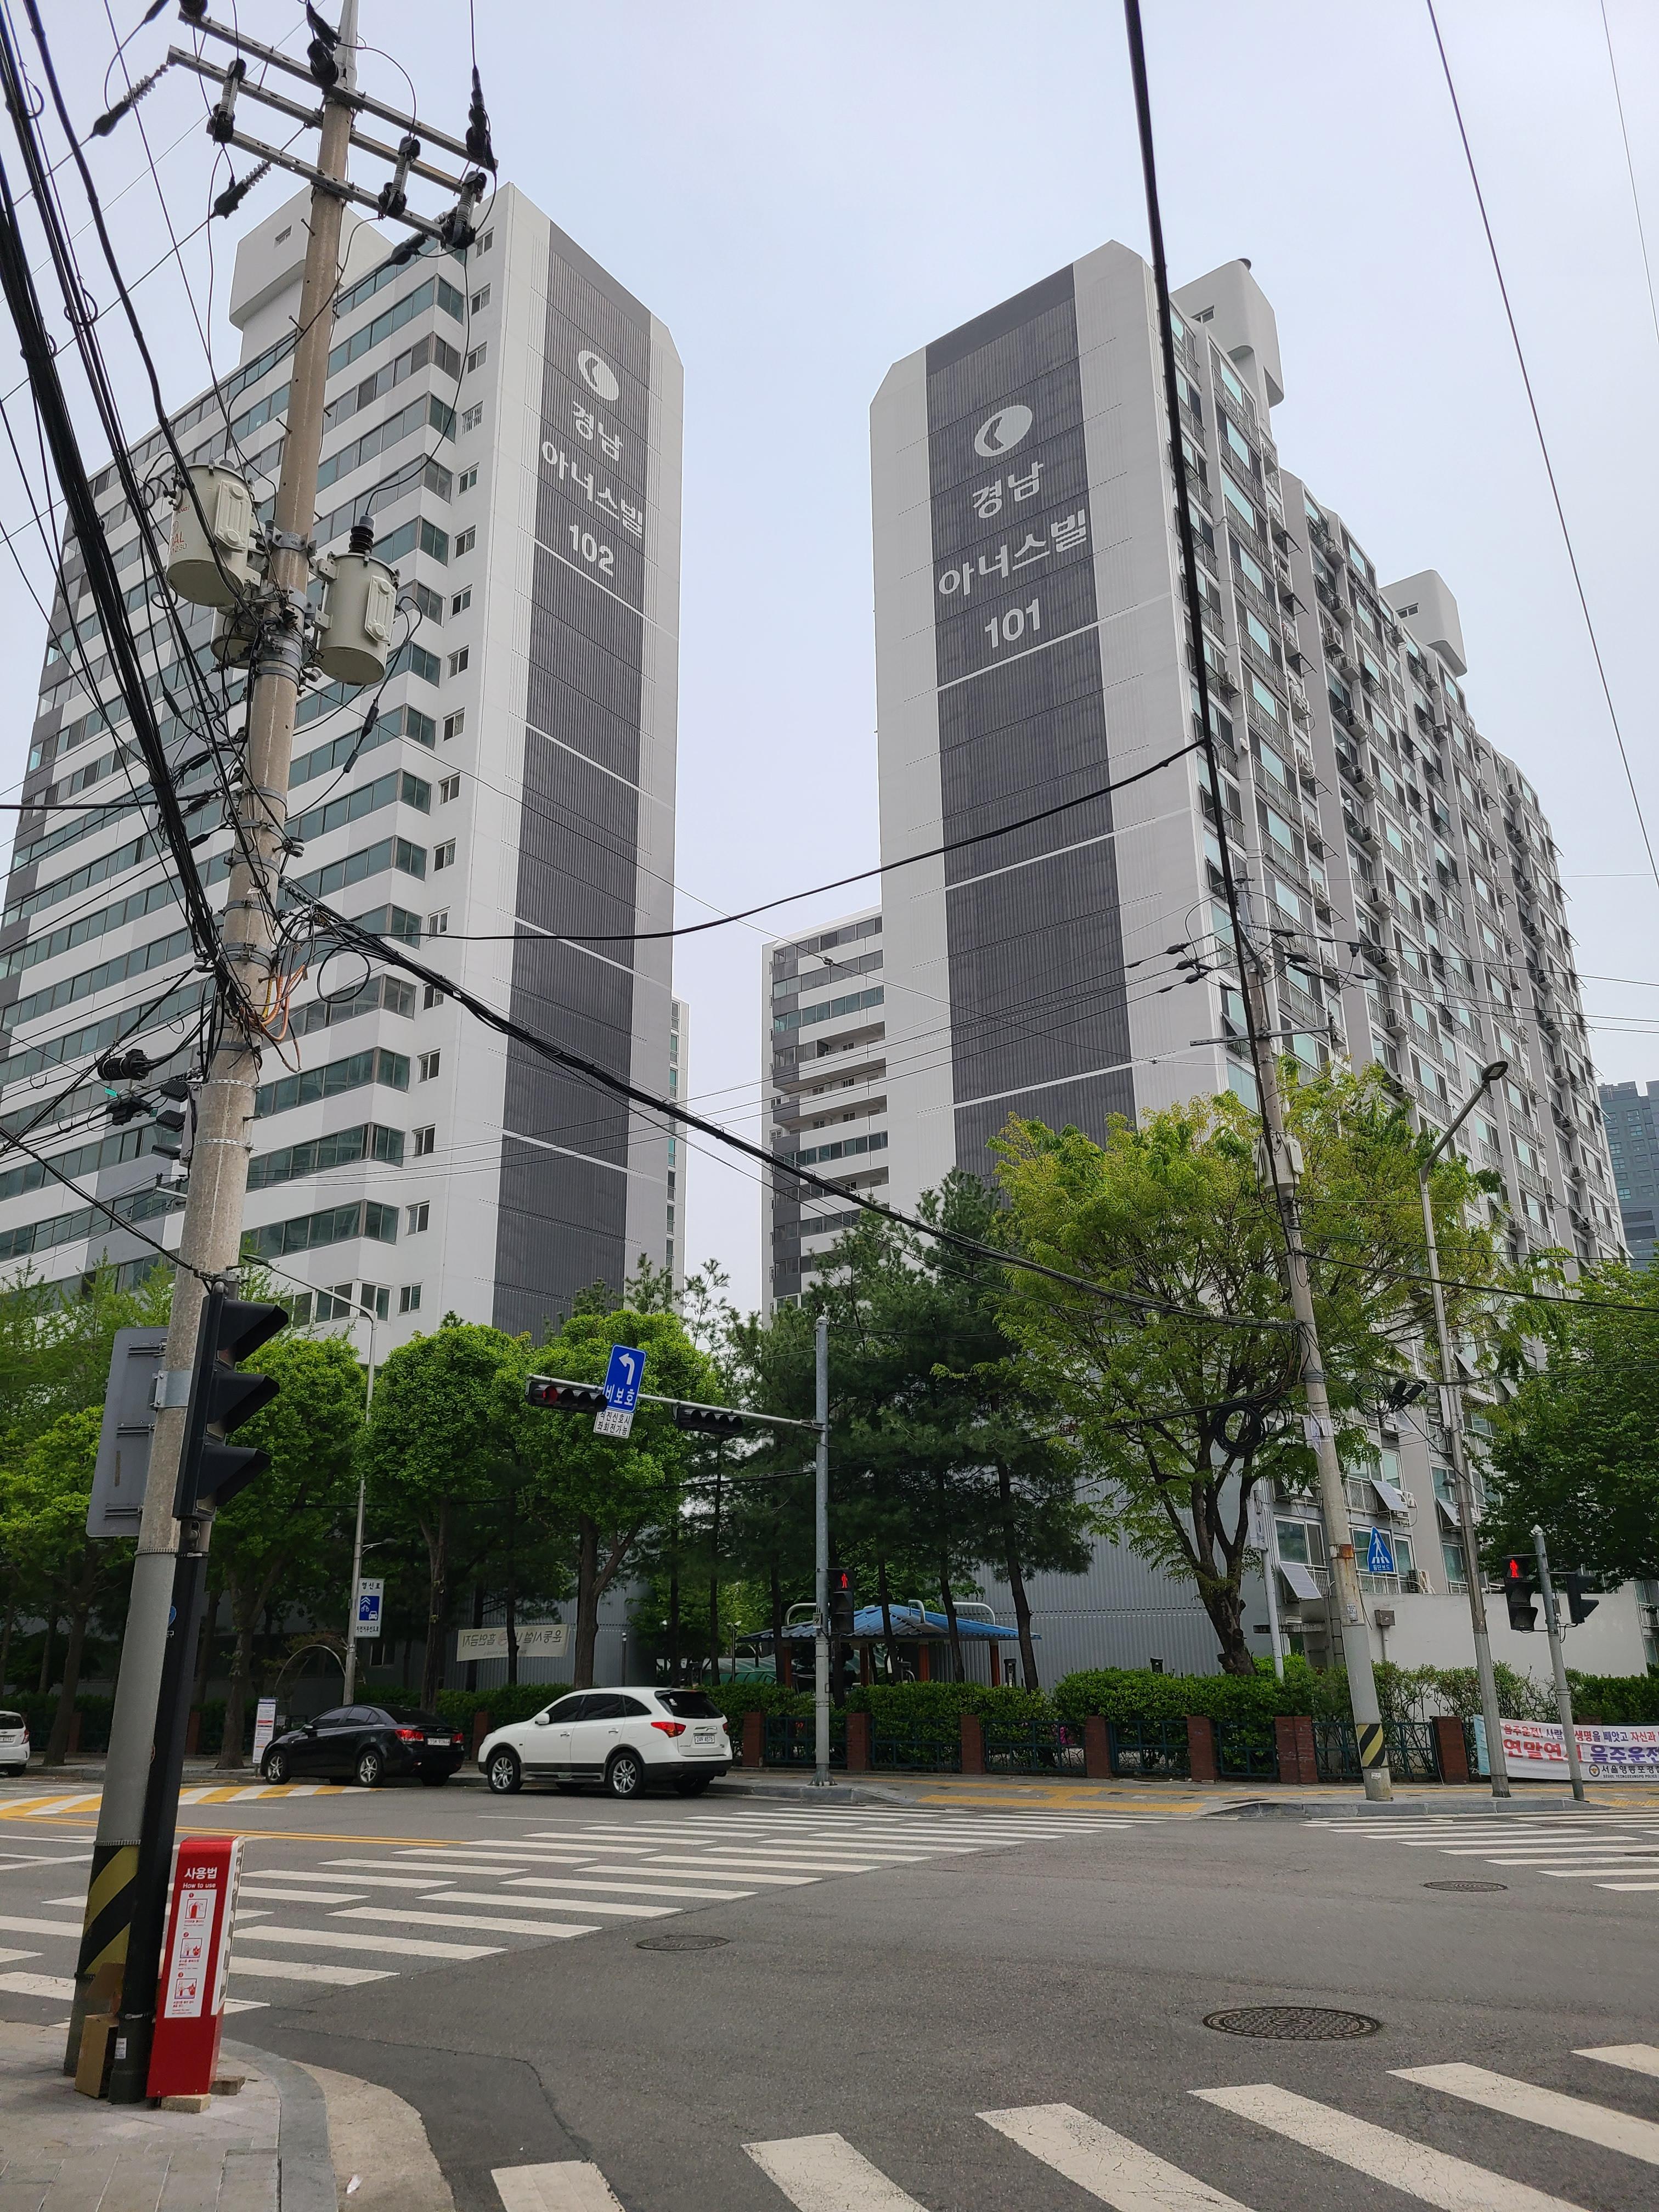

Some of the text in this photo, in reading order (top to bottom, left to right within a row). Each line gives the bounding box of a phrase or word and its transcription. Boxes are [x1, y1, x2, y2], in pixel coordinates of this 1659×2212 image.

[572, 400, 623, 461] 경남
[541, 441, 642, 539] 아너스빌
[972, 461, 1043, 518] 경남
[569, 524, 613, 577] 102
[938, 509, 1087, 596] 아너스빌
[984, 597, 1041, 648] 101
[605, 1384, 635, 1406] 비보호
[597, 1421, 628, 1435] 좌회전가능
[1504, 1724, 1543, 1738] 음주운전!
[1575, 1730, 1601, 1742] 생명을
[1630, 1731, 1656, 1742] 자신과
[184, 1867, 217, 1880] 사용법
